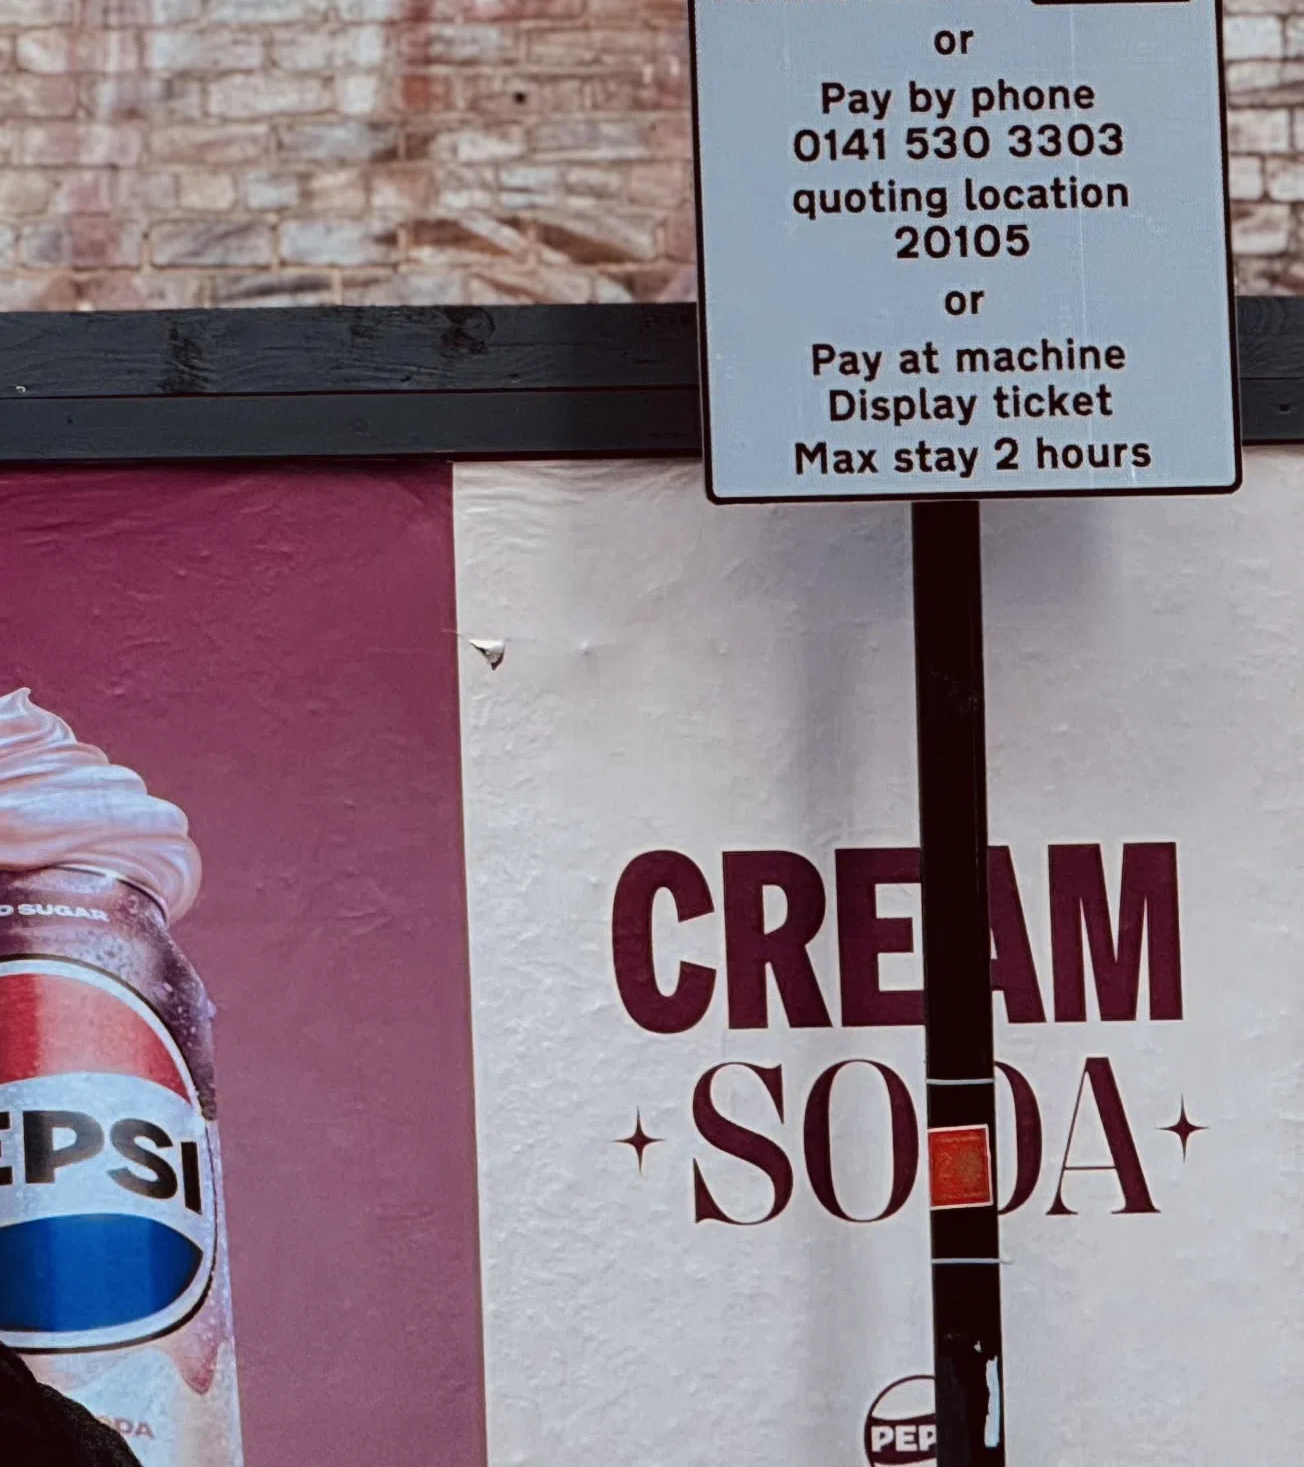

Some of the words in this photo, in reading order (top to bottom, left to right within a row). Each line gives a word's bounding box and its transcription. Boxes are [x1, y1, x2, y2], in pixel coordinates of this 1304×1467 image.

[934, 30, 974, 55] or
[822, 83, 891, 120] Pay
[909, 81, 955, 119] by
[972, 79, 1094, 117] phone
[794, 128, 885, 162] 0141
[906, 126, 989, 160] 530
[1008, 123, 1122, 157] 3303
[793, 179, 947, 220] quoting
[965, 176, 1128, 211] location
[895, 224, 1029, 258] 20105
[945, 291, 984, 315] or
[812, 344, 882, 382] Pay
[900, 342, 939, 374] at
[957, 338, 1125, 372] machine
[830, 387, 977, 426] Display
[993, 384, 1112, 418] ticket
[795, 442, 878, 475] Max
[894, 441, 978, 478] stay
[995, 437, 1018, 470] 2
[1037, 437, 1151, 469] hours
[18, 903, 110, 922] SUGAR
[871, 1424, 937, 1453] PEP
